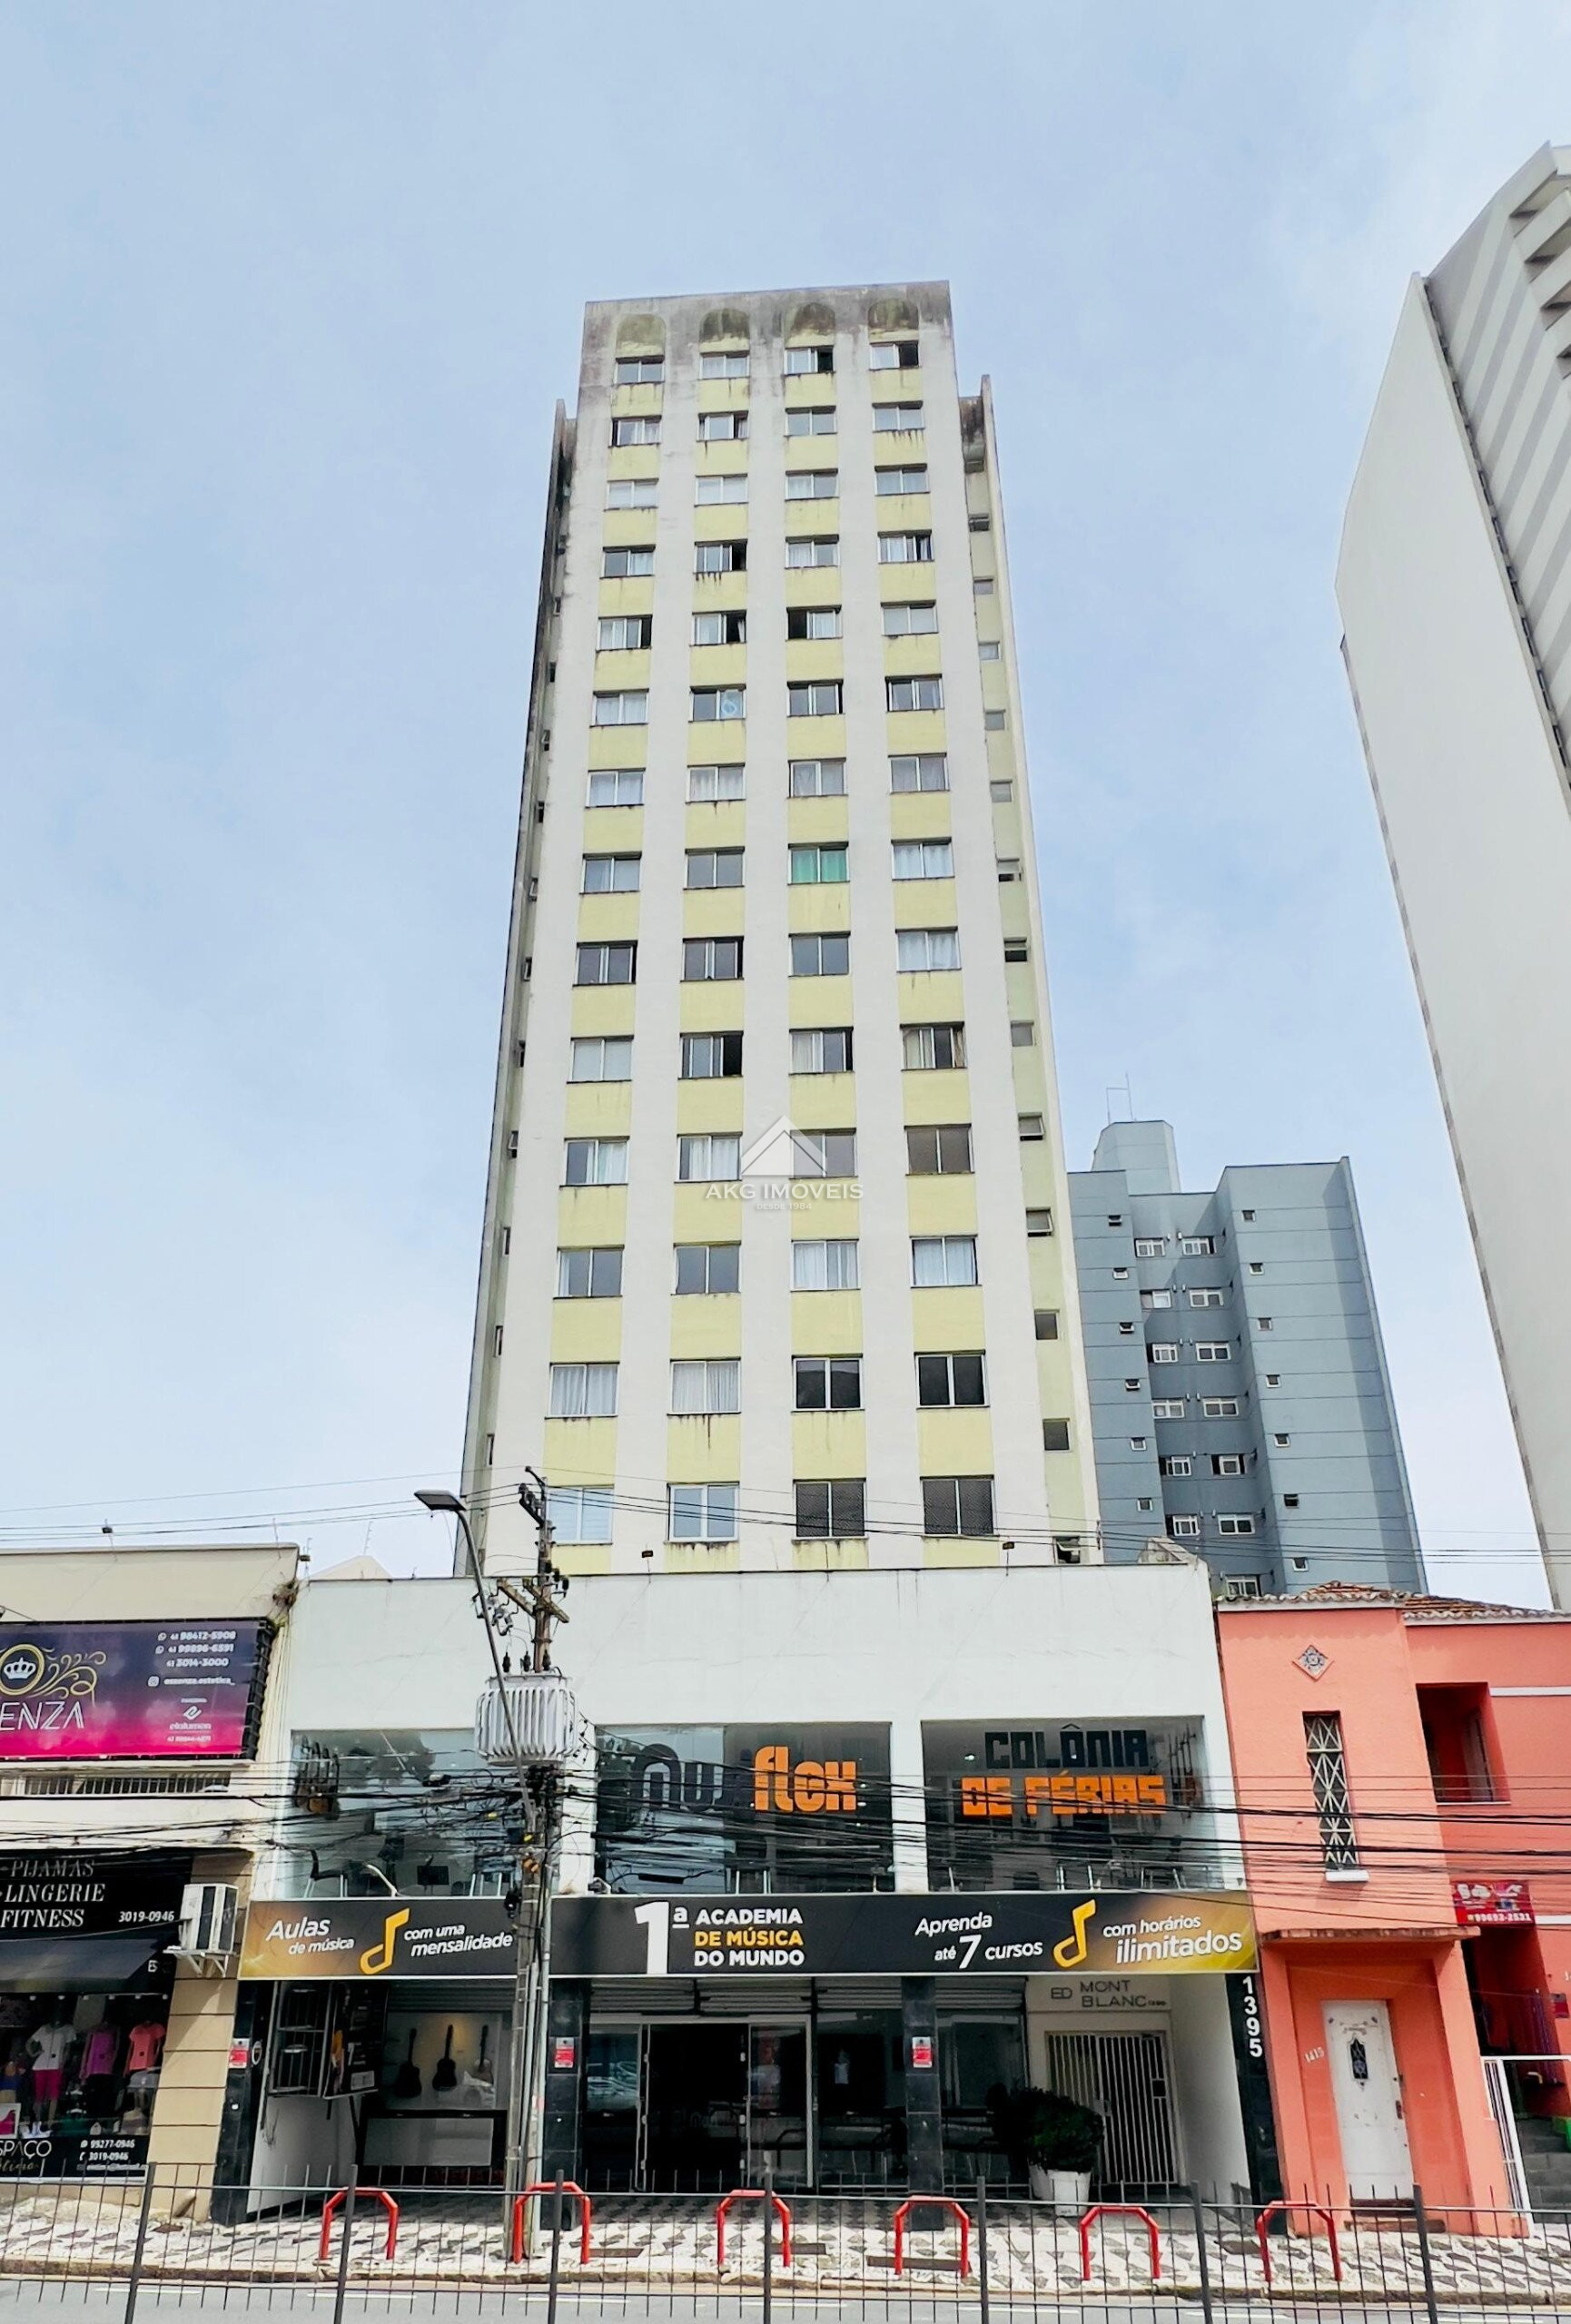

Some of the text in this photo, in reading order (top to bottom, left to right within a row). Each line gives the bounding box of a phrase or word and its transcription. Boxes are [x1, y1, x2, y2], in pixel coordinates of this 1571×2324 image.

[985, 1723, 1149, 1768] COLÔNIA
[962, 1769, 1167, 1817] DE FÉRIAS
[10, 1860, 94, 1877] PIJAMAS
[5, 1884, 105, 1903] LINGERIE
[0, 1909, 84, 1928] FITNESS
[119, 1911, 174, 1923] 3019-0946
[696, 1907, 803, 1925] ACADEMIA
[914, 1912, 993, 1936] Aprenda
[266, 1916, 331, 1941] Aulas
[404, 1925, 465, 1941] com uma
[1102, 1915, 1201, 1937] com horários
[410, 1932, 513, 1956] mensalidade
[695, 1926, 804, 1946] DE MÚSICA
[288, 1937, 354, 1955] de música
[934, 1935, 1043, 1969] até 7 cursos
[1116, 1930, 1242, 1964] ilimitados
[695, 1950, 805, 1966] DO MUNDO
[1080, 1980, 1131, 1992] MONT
[1082, 1995, 1146, 2007] BLANC
[1242, 1975, 1263, 2058] 1395
